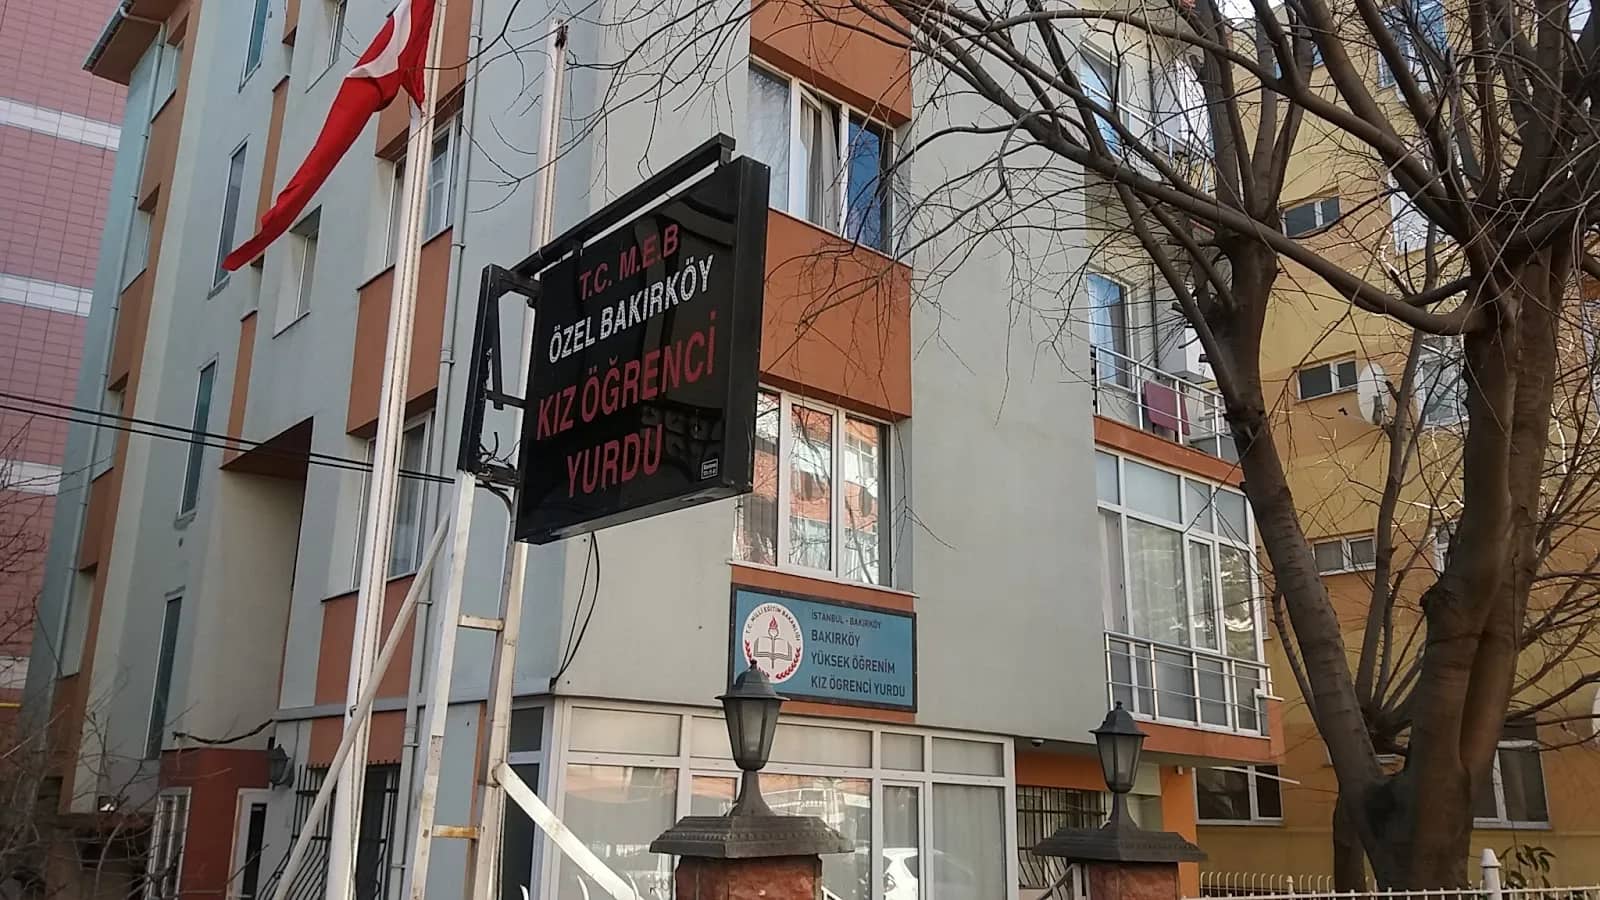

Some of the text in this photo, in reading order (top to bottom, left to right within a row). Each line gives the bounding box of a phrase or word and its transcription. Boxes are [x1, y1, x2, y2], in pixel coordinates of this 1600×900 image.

[579, 224, 679, 300] T.C. M.E.B
[549, 254, 714, 363] ÖZEL BAKIRKÖY
[537, 311, 716, 440] KIZ ÖĞRENCİ
[567, 424, 663, 498] YURDU
[811, 609, 845, 625] İSTANBUL
[811, 629, 860, 648] BAKIRKÖY
[811, 650, 895, 674] YÜKSEK ÖĞRENİM
[811, 675, 827, 689] KIZ
[873, 682, 905, 697] YURDU
